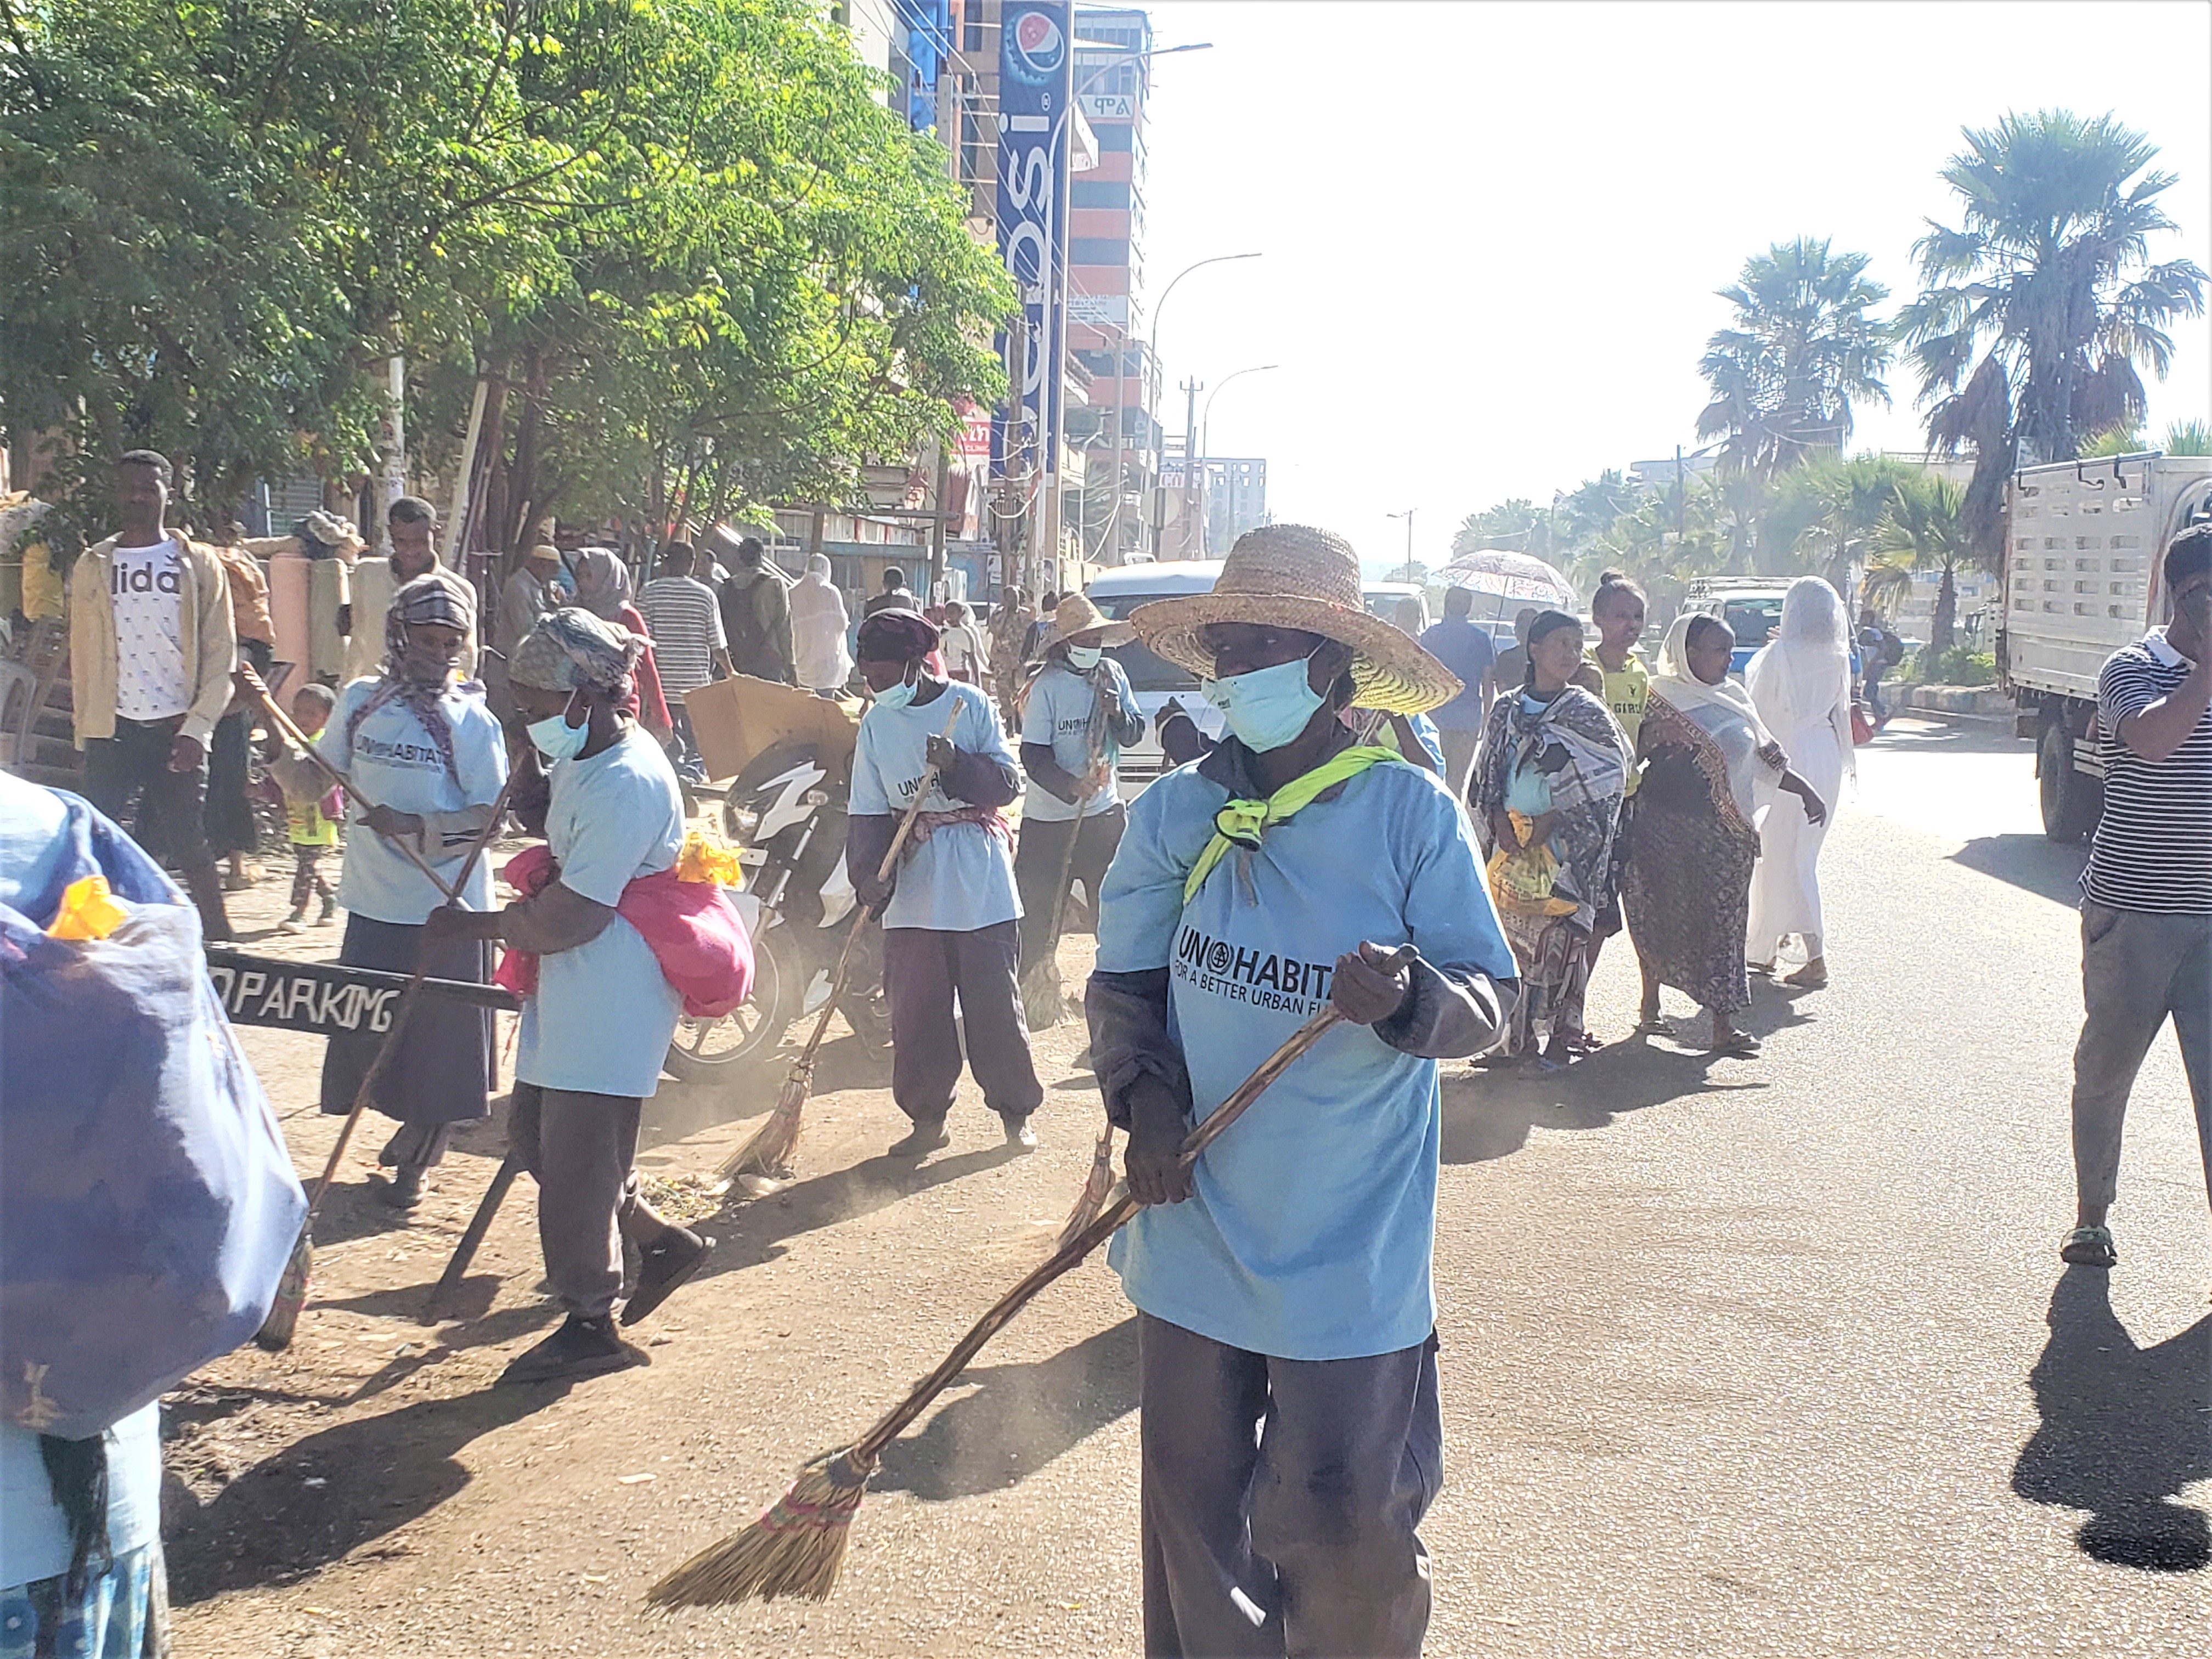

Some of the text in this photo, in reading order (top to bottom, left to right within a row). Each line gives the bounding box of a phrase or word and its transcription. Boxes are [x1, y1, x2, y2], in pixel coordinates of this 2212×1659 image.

[1058, 719, 1073, 731] UN
[898, 777, 919, 797] UN
[1179, 924, 1334, 1000] UN HABIT
[1189, 969, 1198, 986] A
[1200, 973, 1247, 1003] BETTER
[1251, 990, 1304, 1017] URBAN
